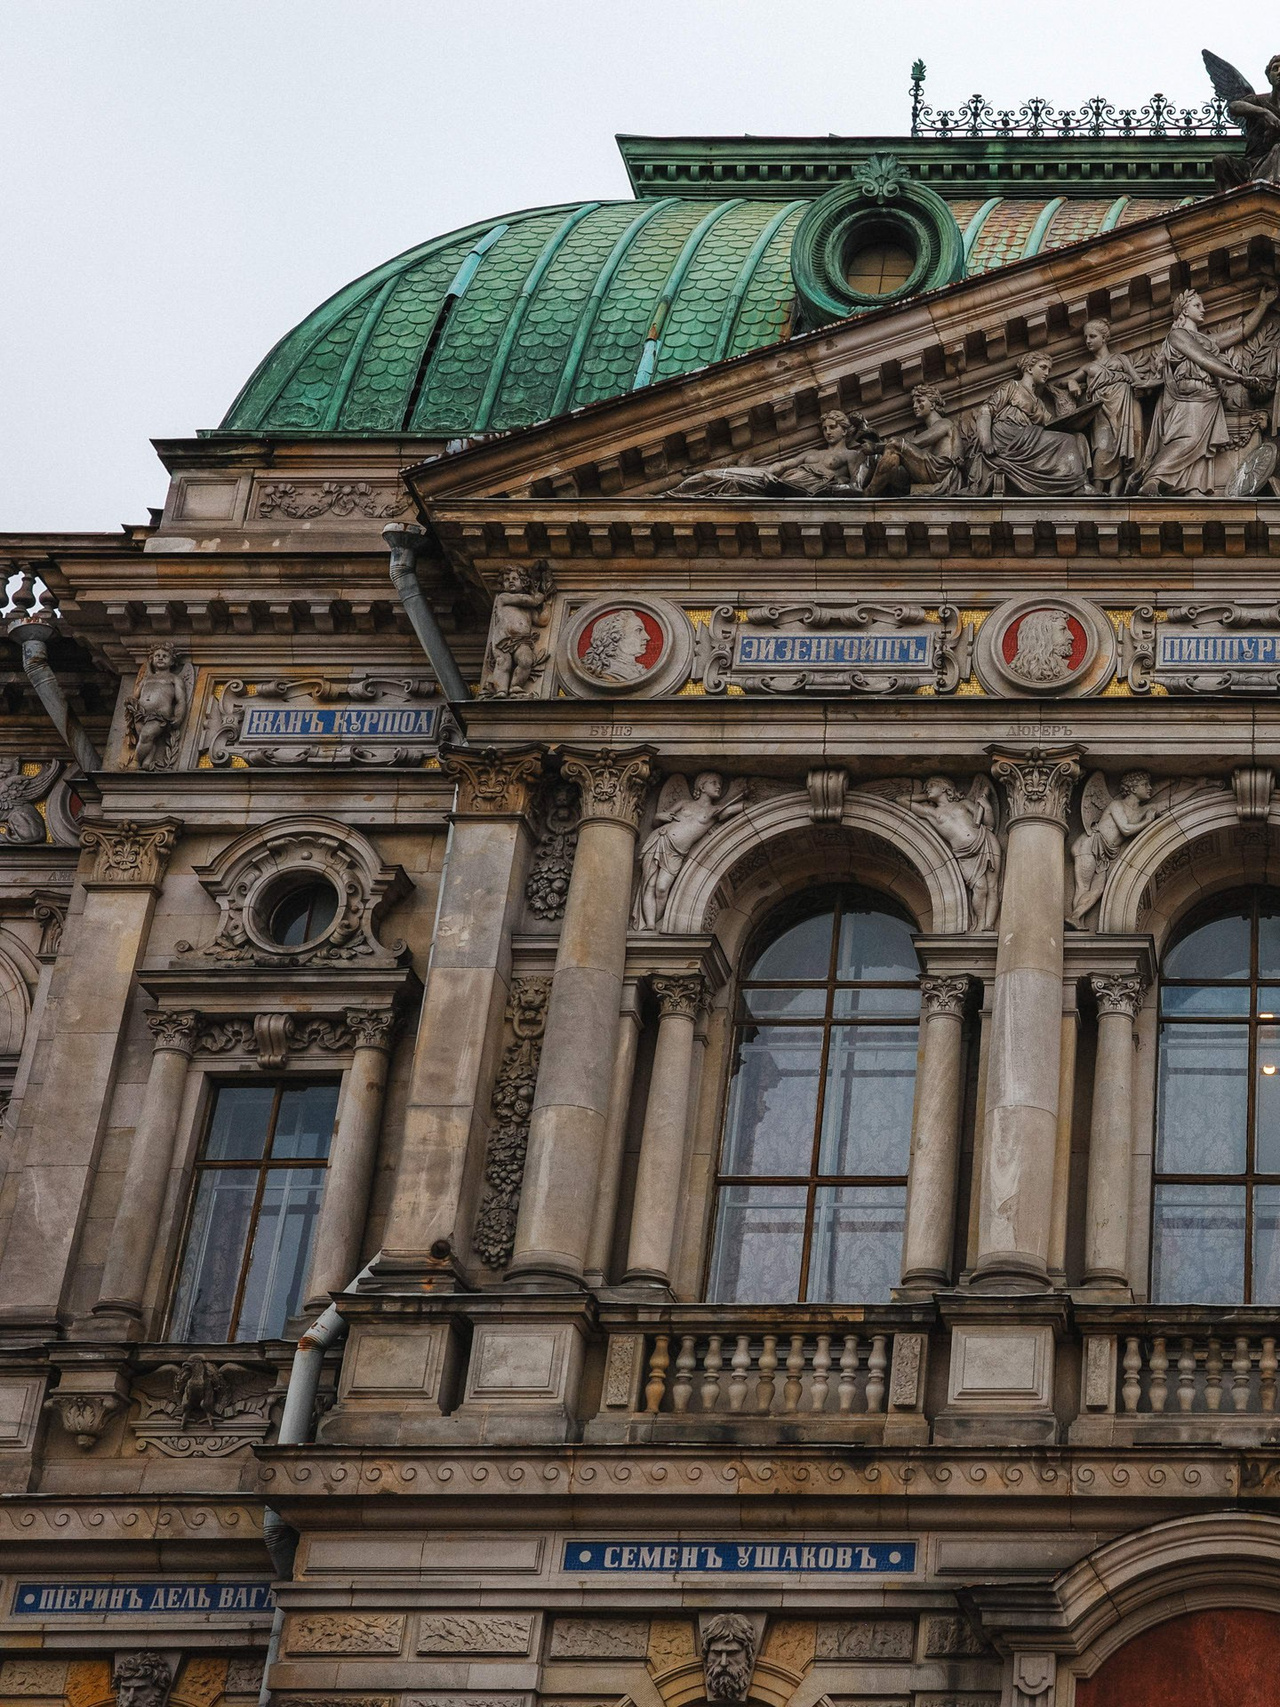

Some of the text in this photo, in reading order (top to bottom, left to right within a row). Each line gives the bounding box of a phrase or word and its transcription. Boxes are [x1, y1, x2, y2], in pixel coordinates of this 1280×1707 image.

[249, 711, 324, 734] ЖАНЪ
[589, 725, 633, 737] БУШЭ
[1006, 725, 1073, 737] ДЮРЕРЪ
[603, 1546, 877, 1569] СЕМЕНЪ УШАКОВЪ
[150, 1587, 214, 1610] ДЕЛЬ
[218, 1587, 277, 1609] ВАГА
